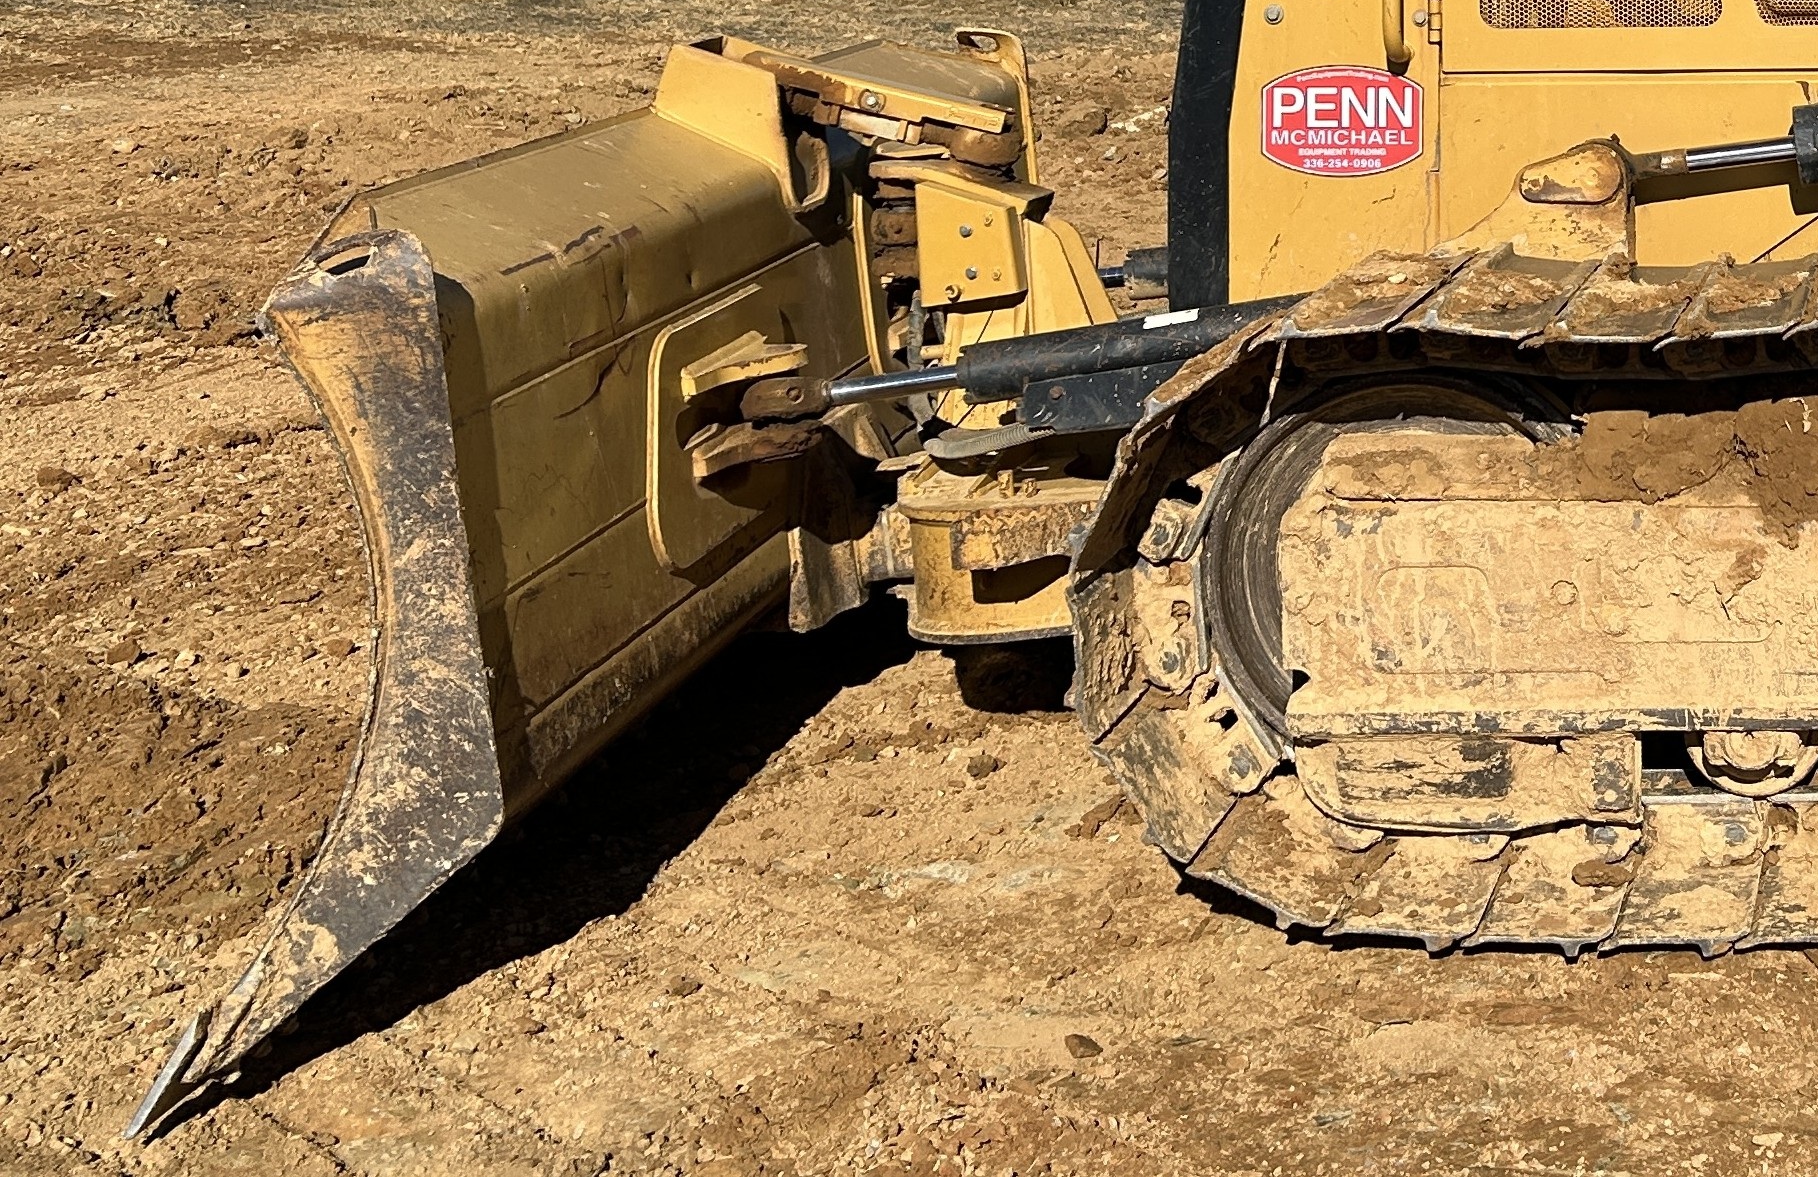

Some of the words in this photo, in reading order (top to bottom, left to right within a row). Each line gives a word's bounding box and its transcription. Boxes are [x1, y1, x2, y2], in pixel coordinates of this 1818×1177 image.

[1272, 86, 1414, 128] PENN
[1270, 129, 1414, 145] MCMICHAEL
[1298, 147, 1347, 156] EQUIPMENT
[1349, 147, 1387, 156] TRADING
[1303, 158, 1382, 168] 336-254-0906
